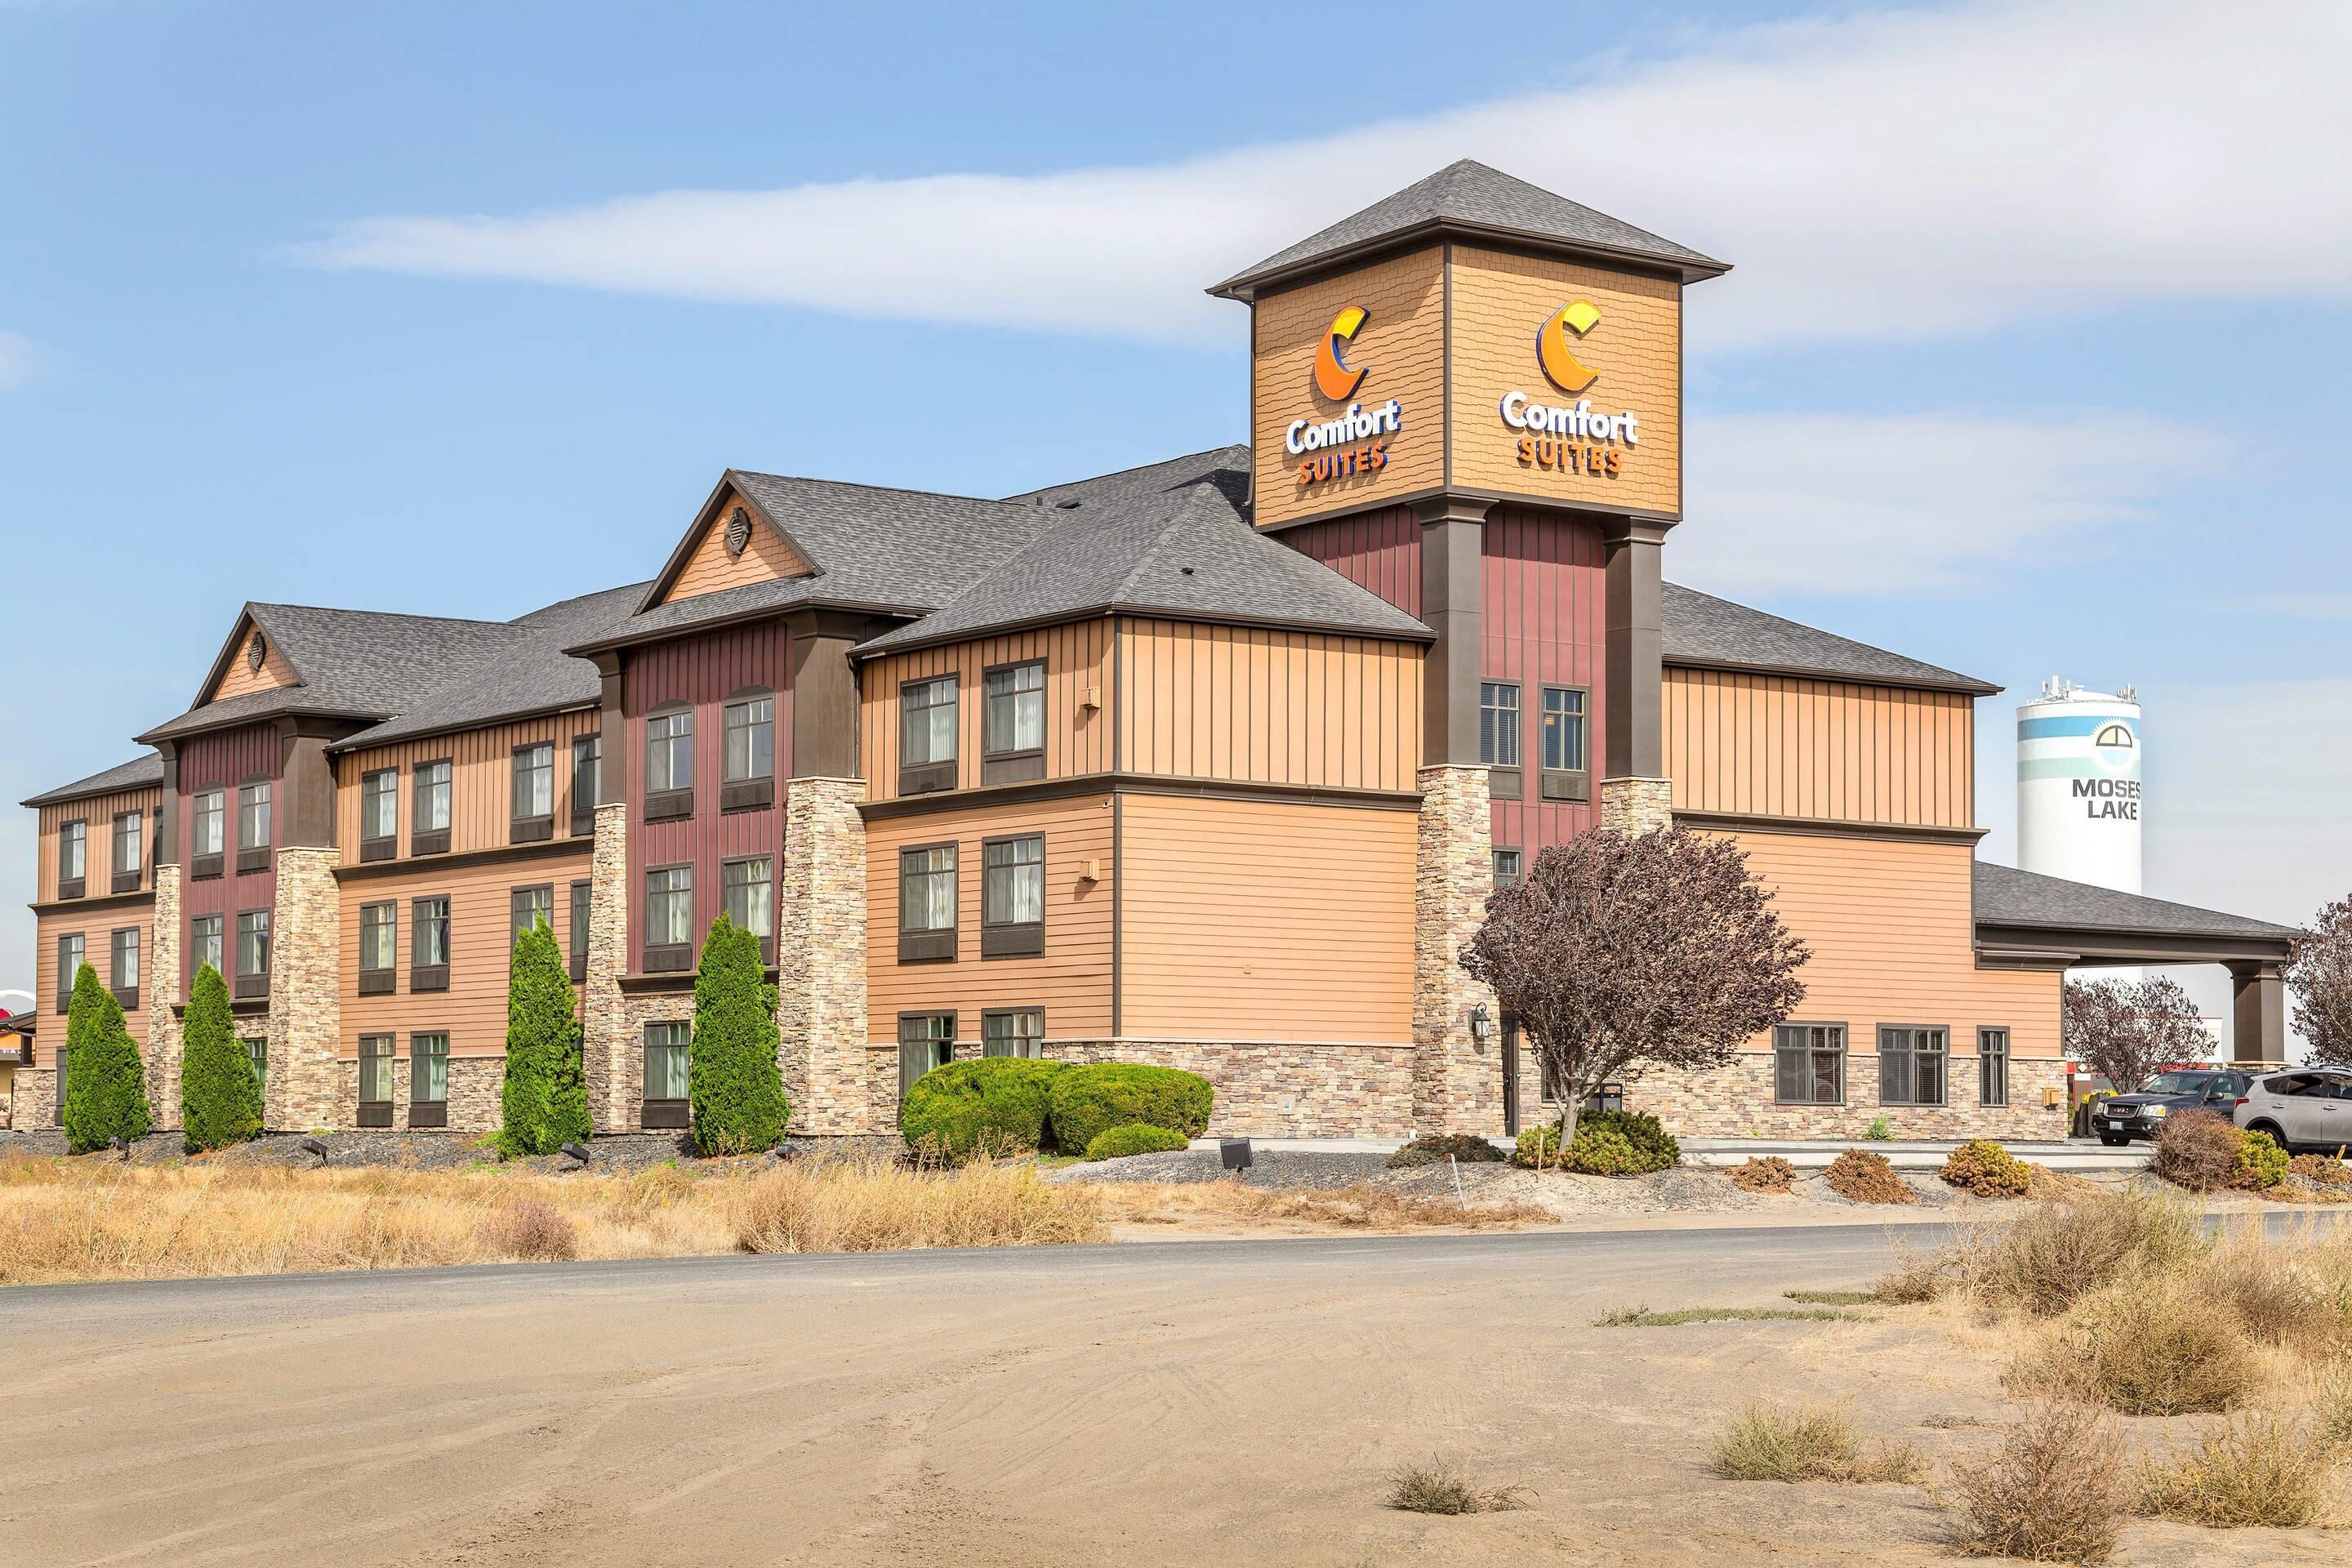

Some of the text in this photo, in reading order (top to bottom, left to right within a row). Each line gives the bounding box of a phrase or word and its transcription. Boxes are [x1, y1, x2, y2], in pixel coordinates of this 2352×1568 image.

[1285, 399, 1402, 455] Comfort
[1499, 390, 1639, 443] Comfort
[1298, 443, 1388, 484] SUITES
[1517, 436, 1622, 473] SUITES
[2072, 778, 2141, 800] MOSES
[2087, 800, 2137, 821] LAKE
